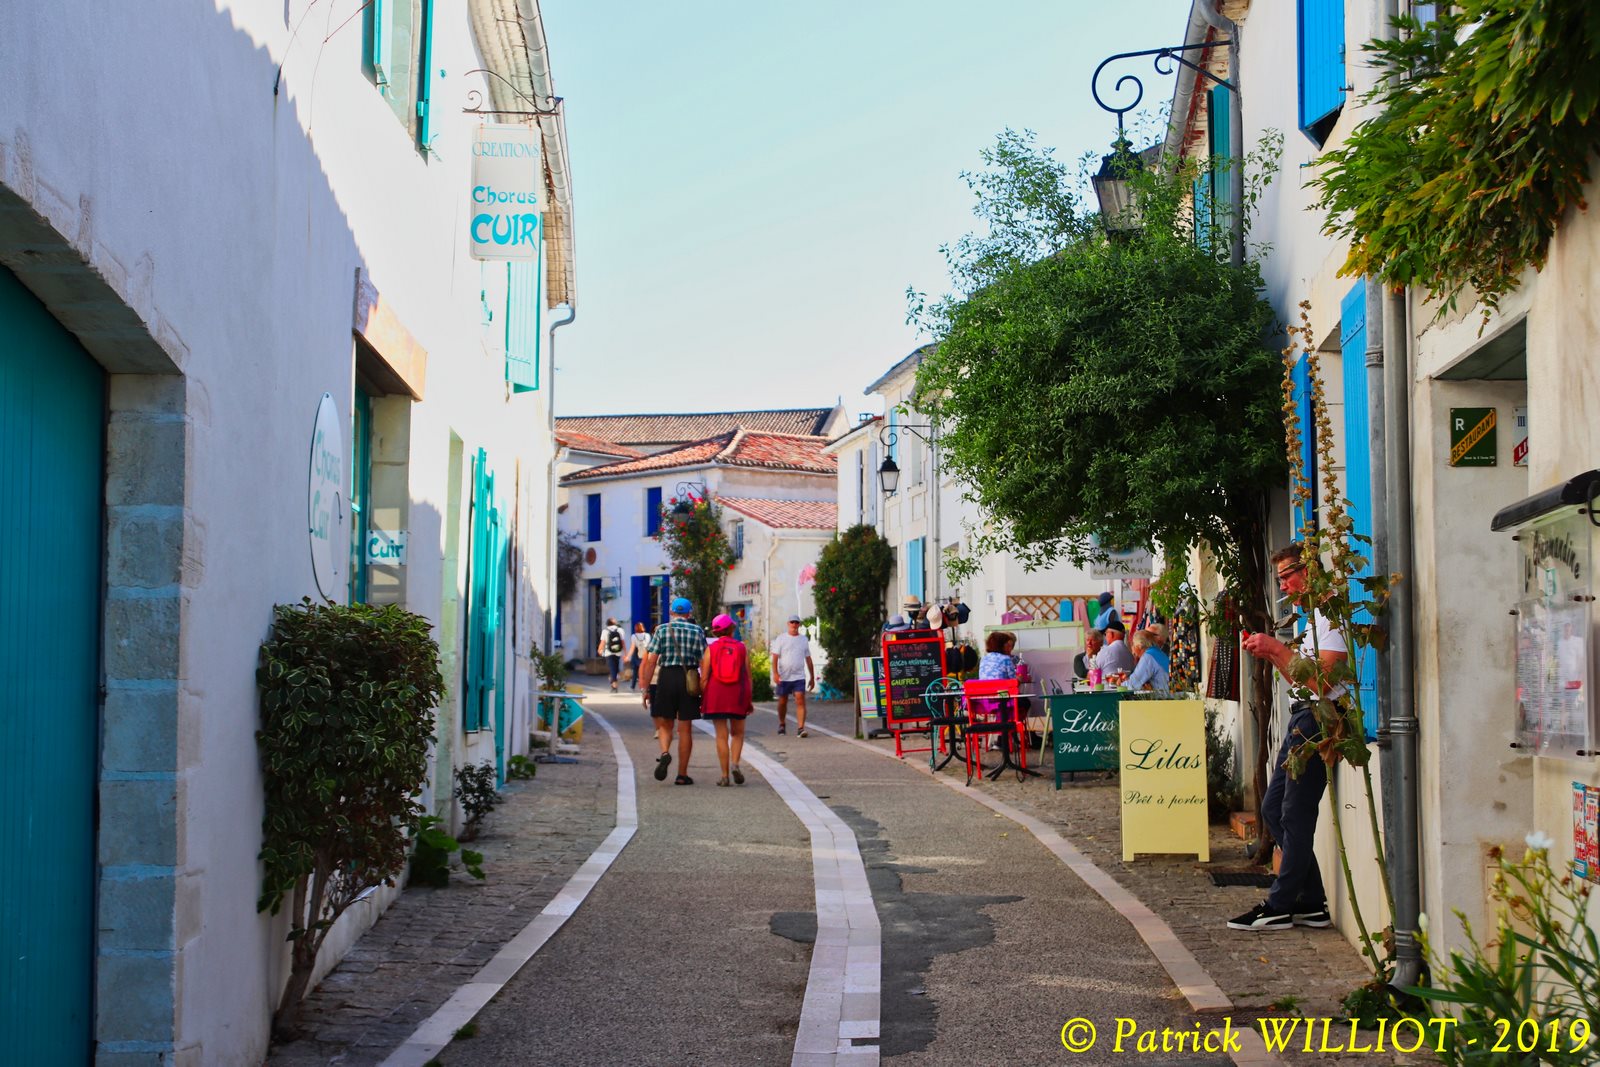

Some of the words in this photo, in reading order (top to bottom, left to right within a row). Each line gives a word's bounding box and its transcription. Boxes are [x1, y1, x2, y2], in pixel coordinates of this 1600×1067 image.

[472, 186, 537, 206] Chorus
[471, 213, 538, 250] CUIR
[1455, 418, 1465, 431] R
[1451, 412, 1495, 462] RESTAURANT
[1518, 441, 1528, 458] LI
[367, 536, 404, 558] Cuir
[891, 678, 920, 687] GAUFRES
[1060, 708, 1116, 734] Lilas
[1058, 742, 1080, 754] Prêt
[1083, 744, 1089, 752] à
[1125, 738, 1202, 771] Lilas
[1124, 790, 1153, 805] Prêt
[1157, 794, 1165, 804] à
[1168, 794, 1206, 809] porter
